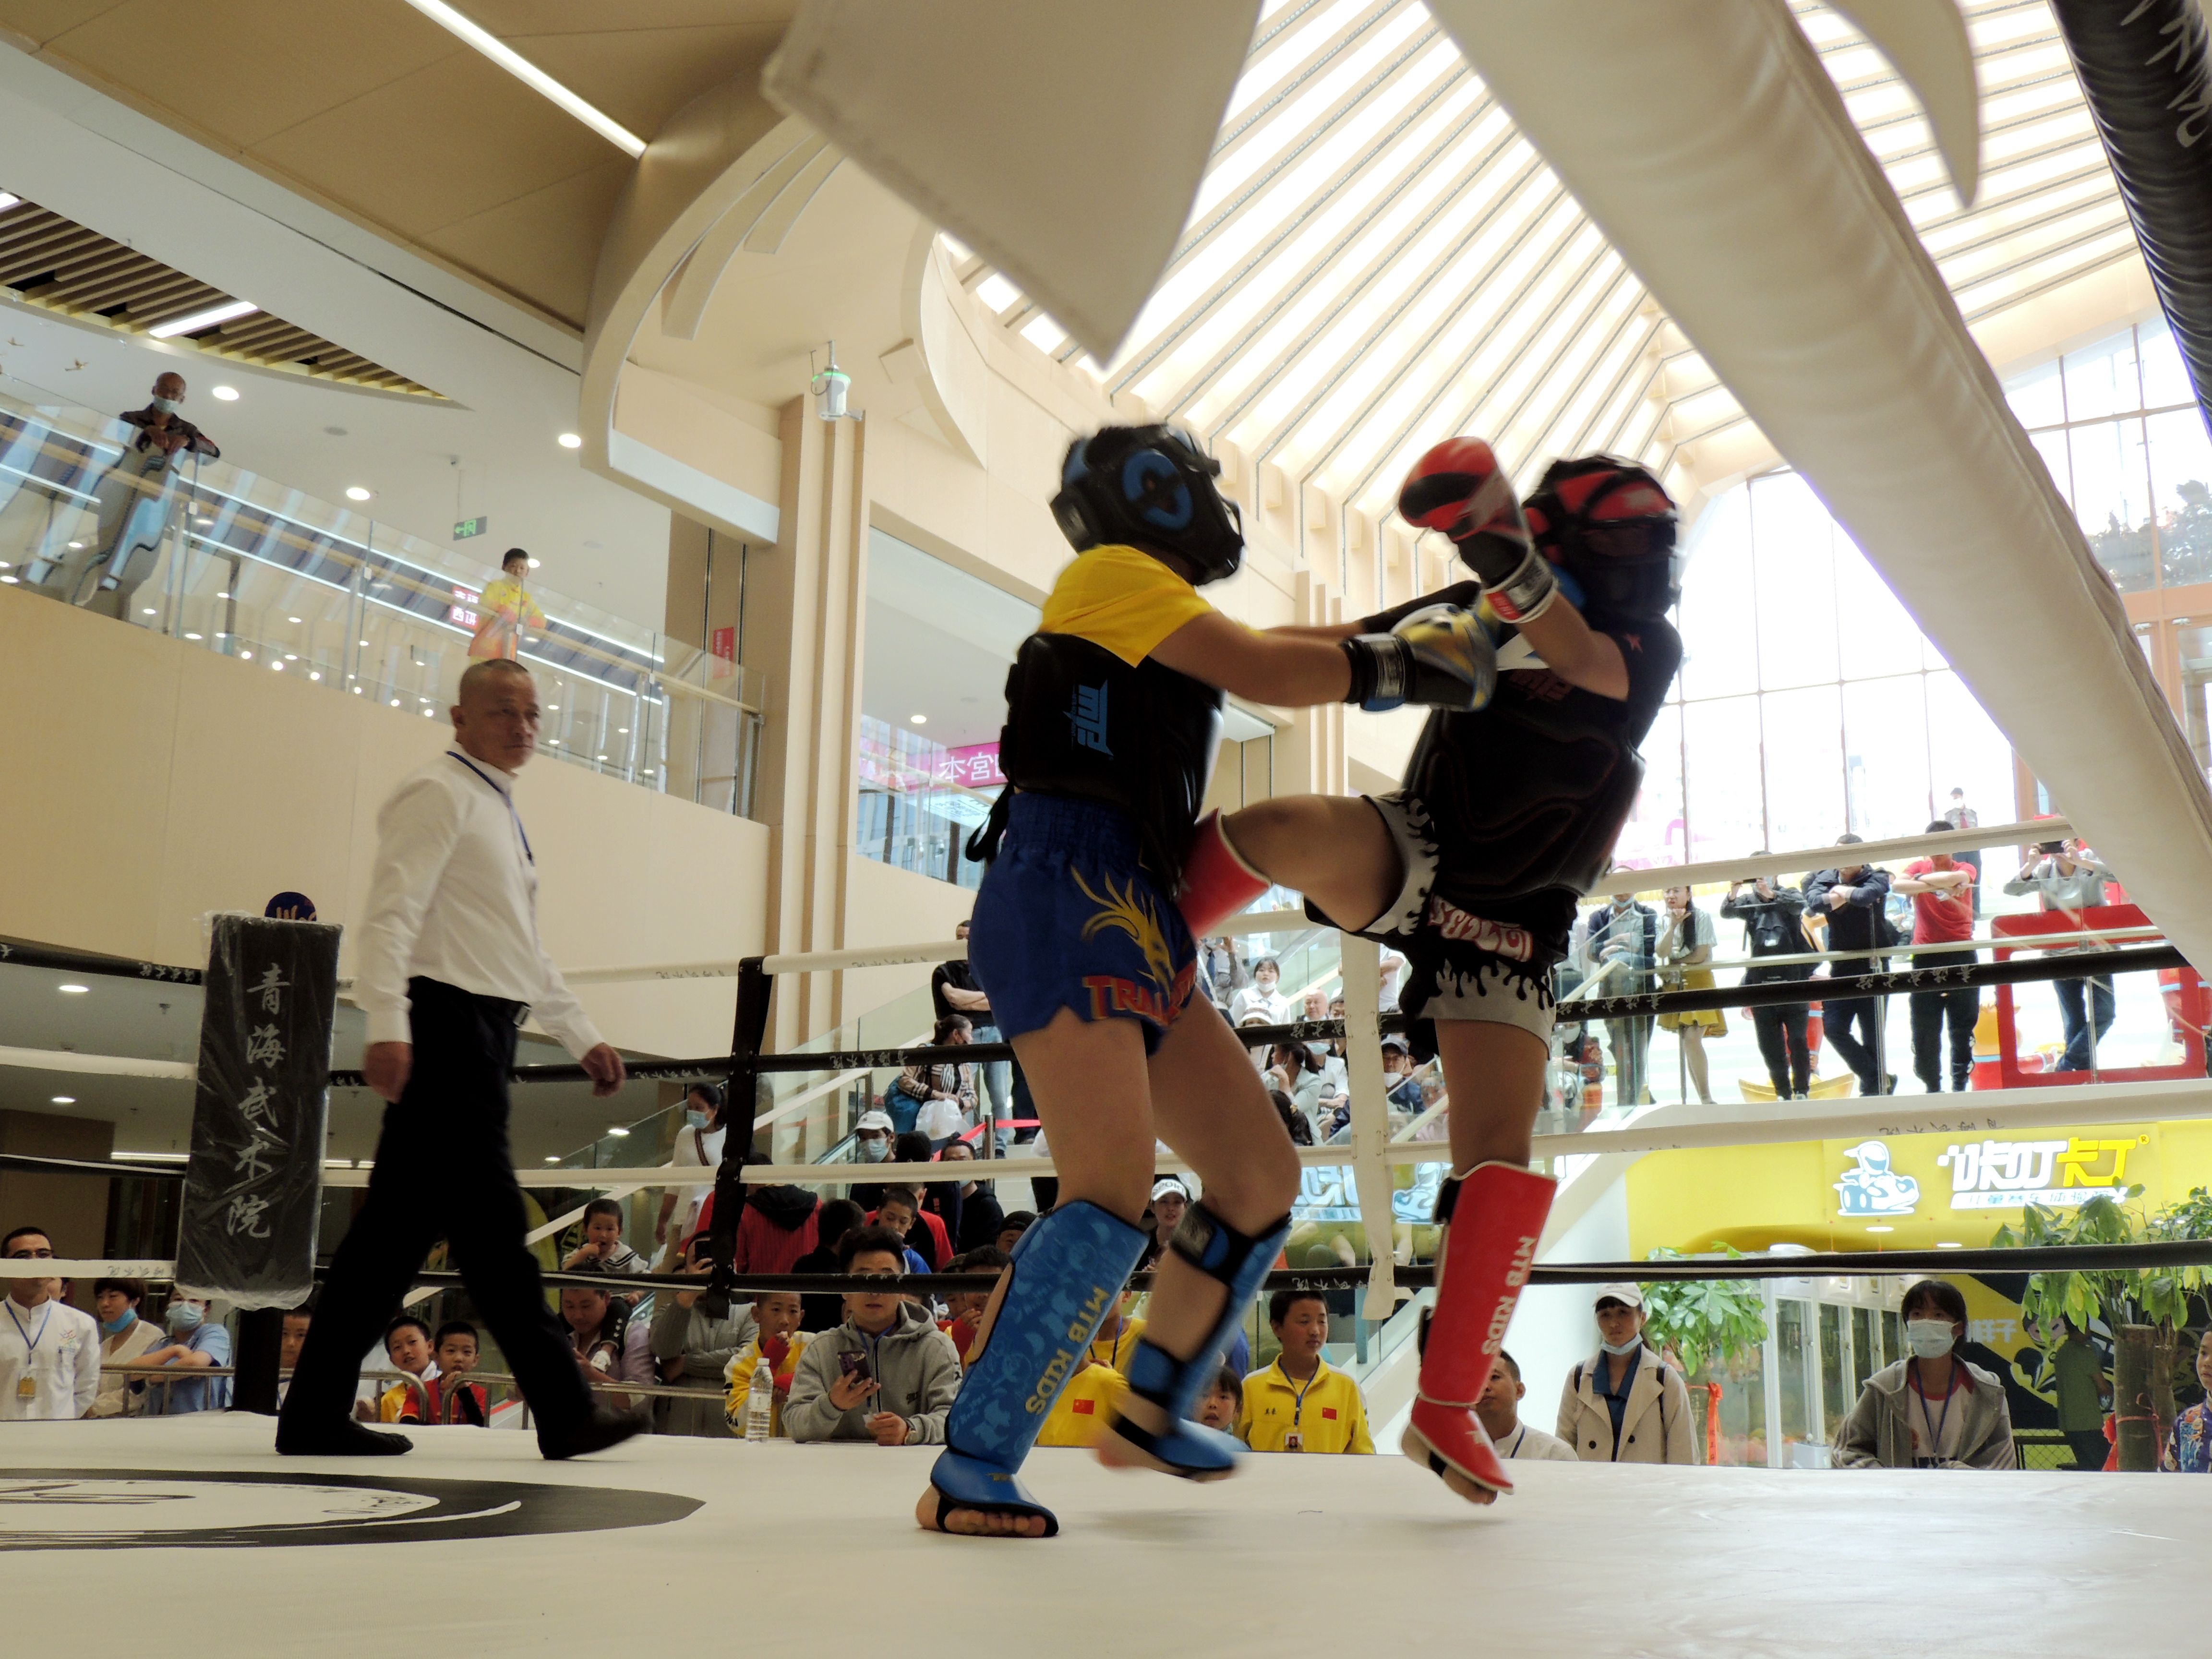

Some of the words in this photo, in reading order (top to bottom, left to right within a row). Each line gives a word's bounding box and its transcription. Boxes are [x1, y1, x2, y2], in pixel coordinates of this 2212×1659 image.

[227, 962, 289, 1238] 青海武术院
[1152, 1181, 1184, 1194] SPORT
[1504, 1235, 1537, 1287] MTB
[1068, 1286, 1111, 1344] MTB
[1481, 1295, 1517, 1356] KIDS
[1967, 1319, 2017, 1344] 样子
[1025, 1347, 1074, 1415] KIDS
